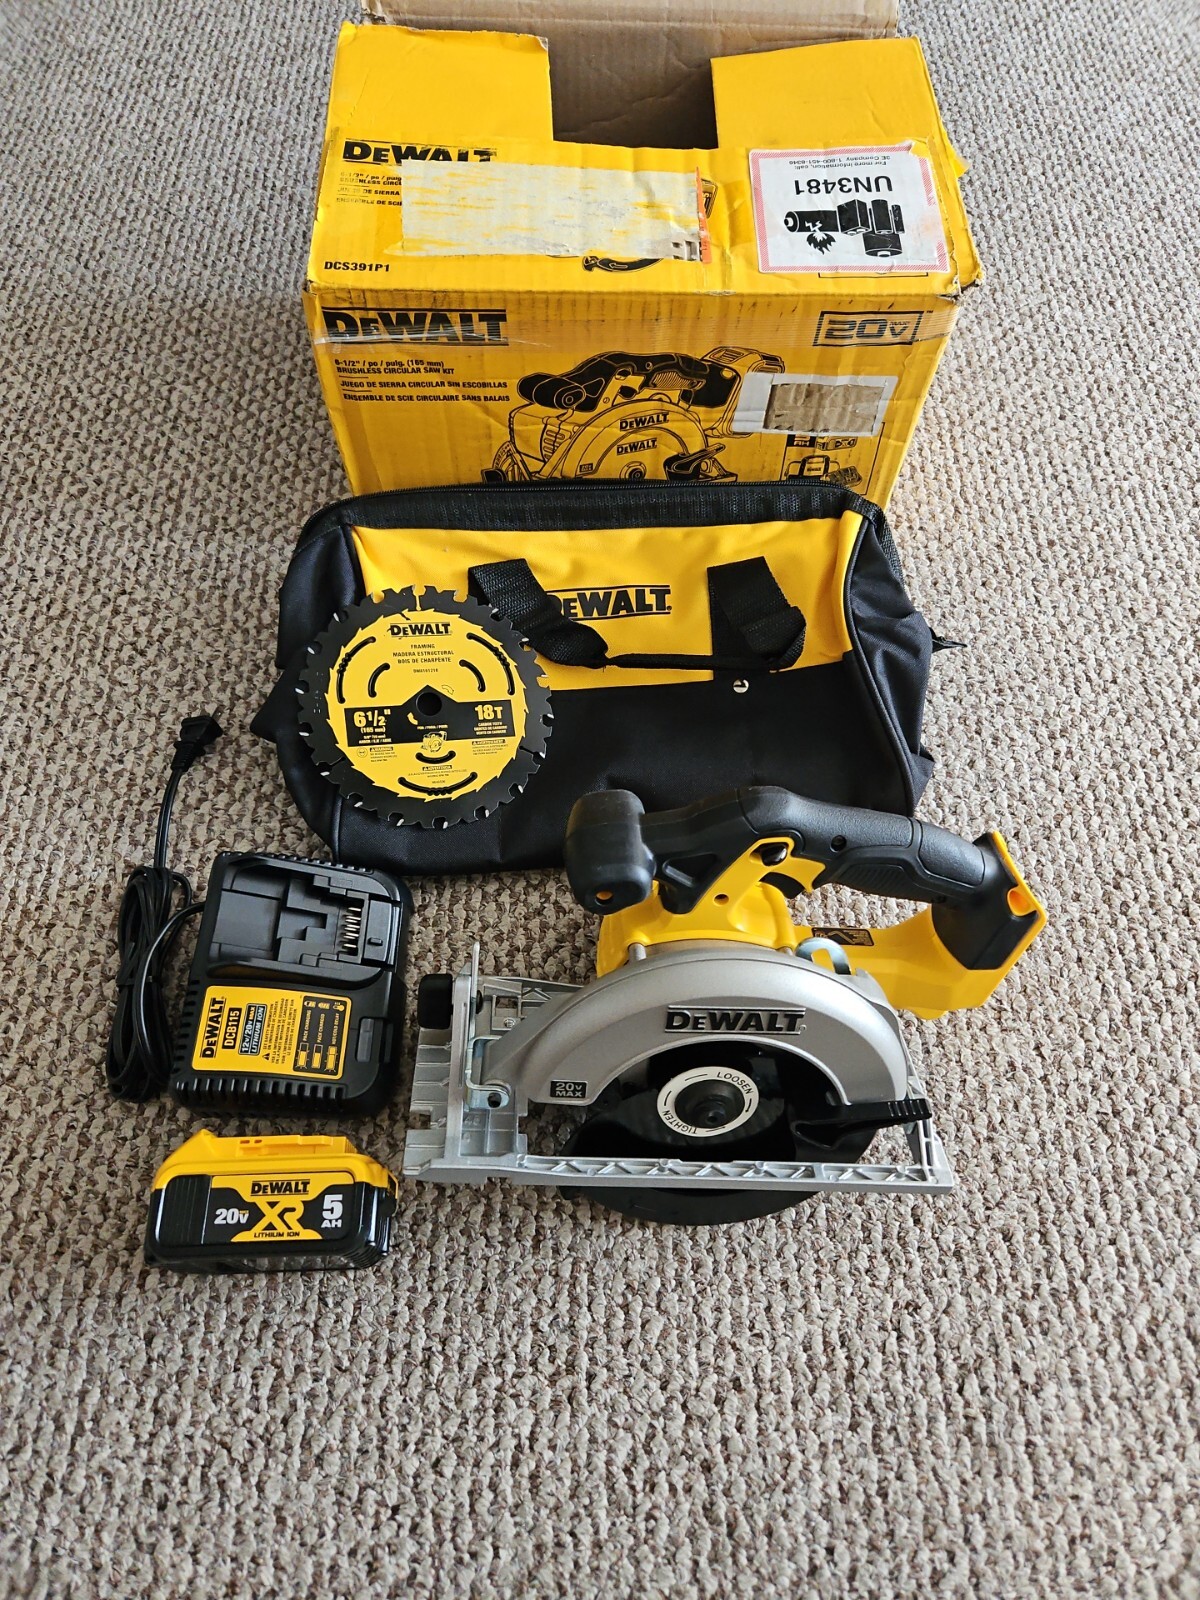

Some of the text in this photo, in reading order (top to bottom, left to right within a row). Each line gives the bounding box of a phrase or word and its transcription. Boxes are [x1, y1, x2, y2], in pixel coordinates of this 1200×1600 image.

[794, 176, 892, 195] UN3481
[324, 261, 390, 272] DCS391P1
[322, 310, 507, 342] DEWALT
[340, 380, 365, 388] JUEGO
[620, 413, 669, 429] DEWALT
[617, 439, 657, 454] DEWALT
[390, 624, 450, 635] DEWALT
[475, 704, 503, 720] 18T
[202, 998, 224, 1057] DEWALT
[224, 1011, 240, 1046] DCB115
[665, 1010, 804, 1032] DEWALT
[252, 1022, 261, 1052] LITHIUM
[716, 1072, 753, 1094] LOOSEN
[662, 1110, 697, 1134] TIGHTEN
[251, 1182, 310, 1194] DEWALT
[250, 1200, 304, 1230] XR
[322, 1194, 343, 1220] 5
[321, 1220, 342, 1228] AH
